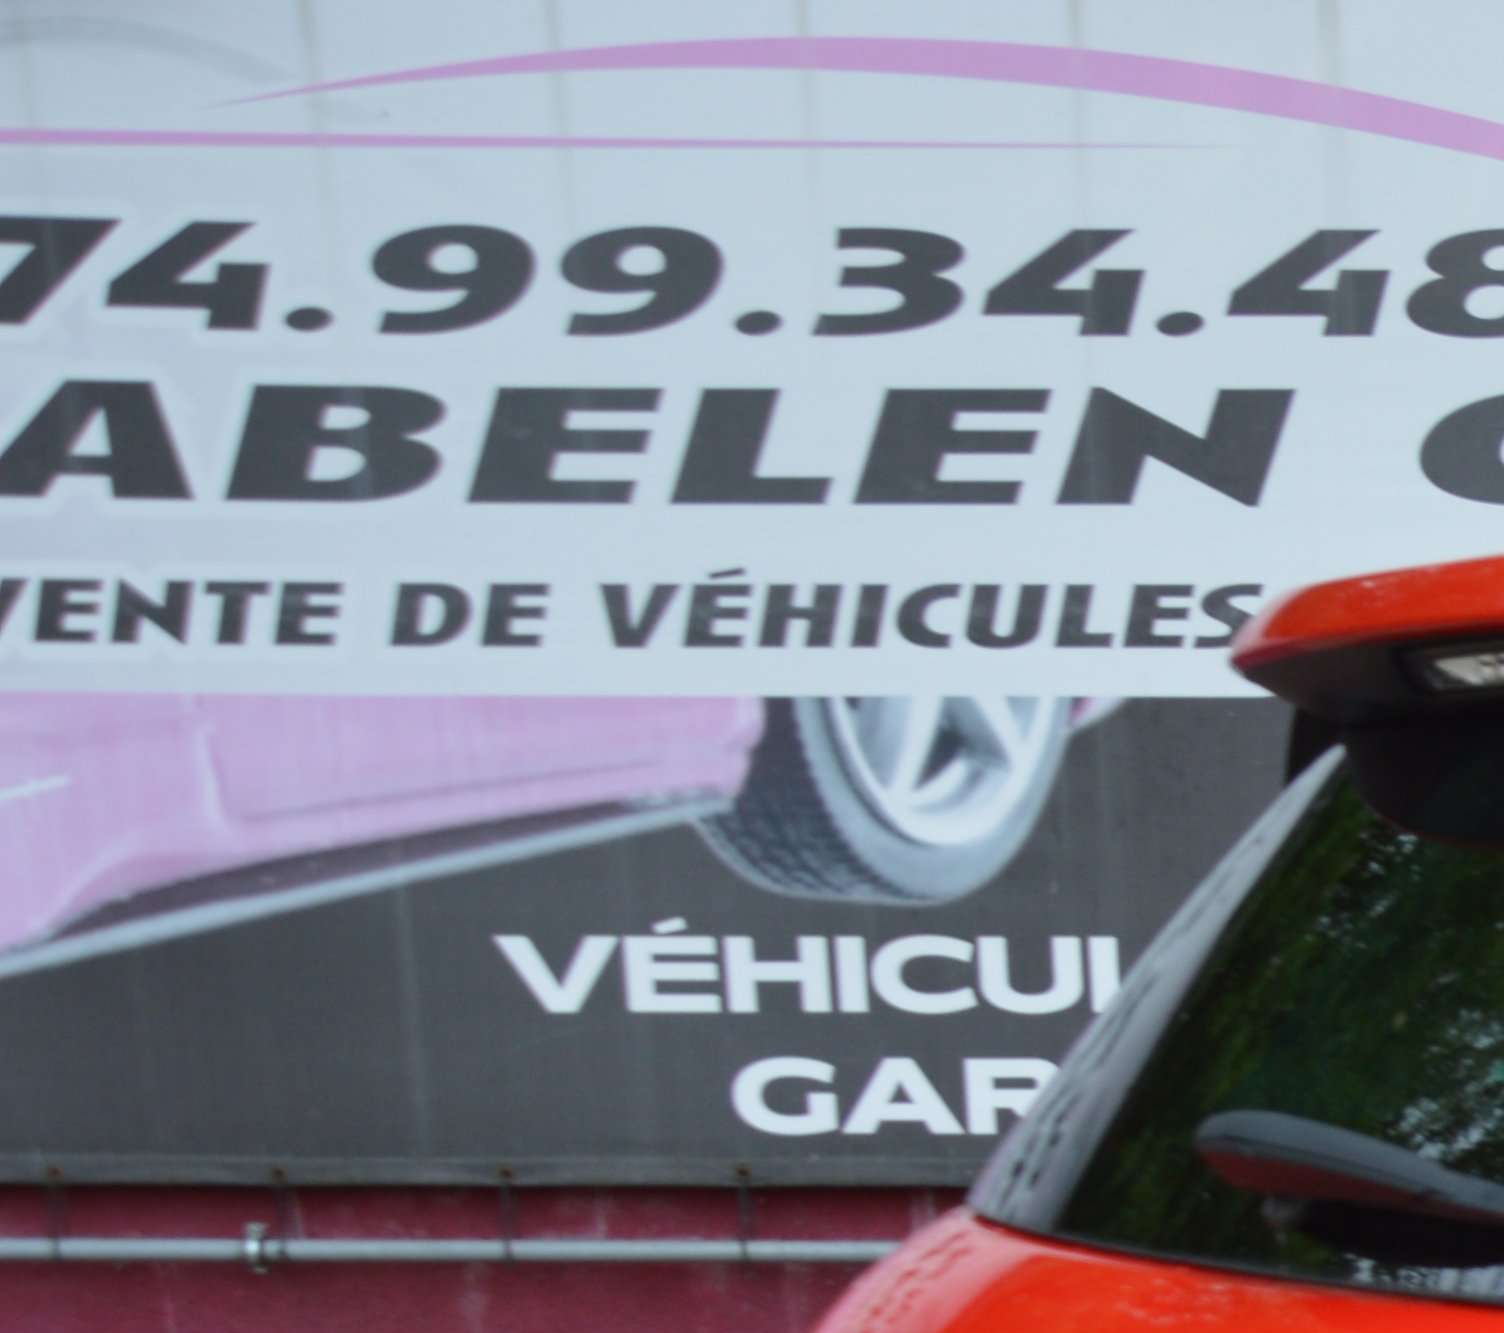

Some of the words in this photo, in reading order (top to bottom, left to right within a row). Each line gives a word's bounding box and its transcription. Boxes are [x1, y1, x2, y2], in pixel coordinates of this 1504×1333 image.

[0, 380, 1297, 507] ABELEN
[390, 581, 551, 648] DE
[599, 567, 1266, 649] VÉHICULES
